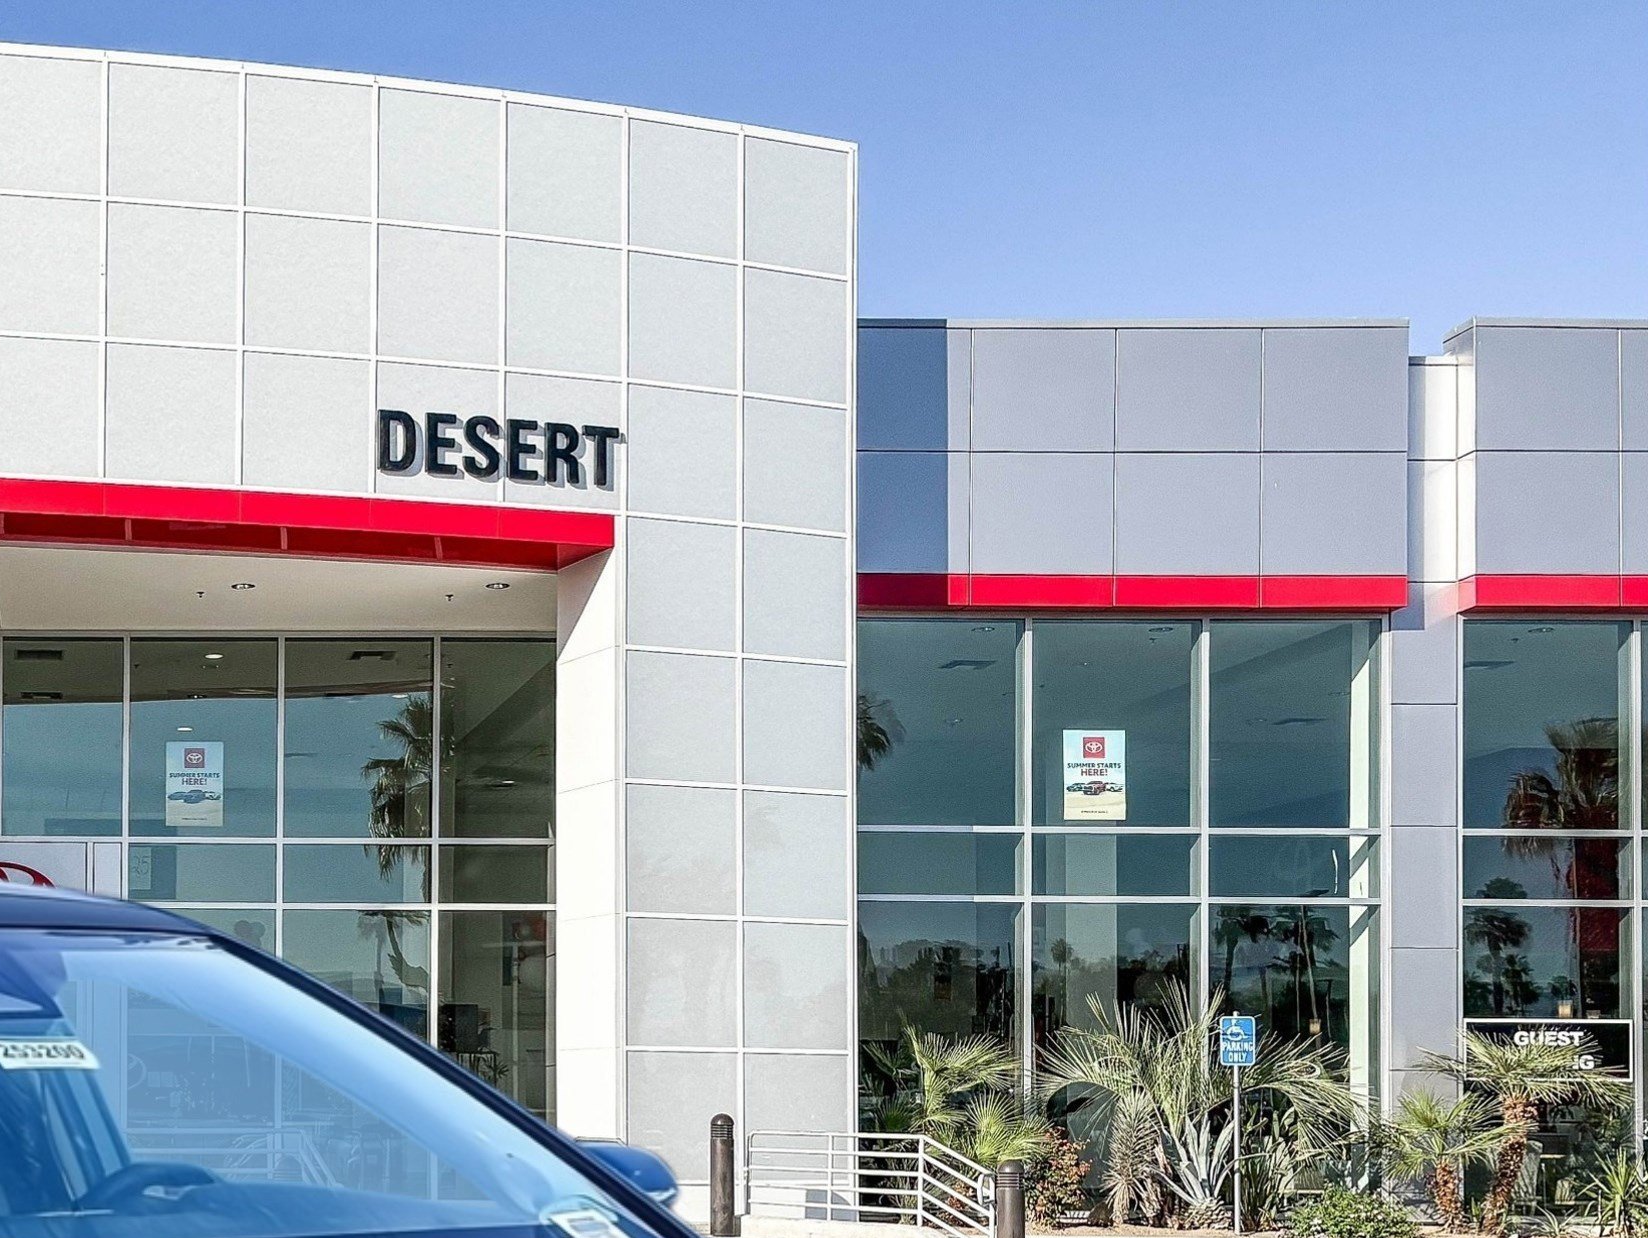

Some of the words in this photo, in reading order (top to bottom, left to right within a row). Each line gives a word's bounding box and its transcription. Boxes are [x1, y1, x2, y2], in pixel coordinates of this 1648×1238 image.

[376, 408, 620, 487] DESERT
[1080, 768, 1108, 776] HERE!
[1513, 1031, 1584, 1047] GUEST
[1222, 1041, 1253, 1052] PARKING
[1228, 1052, 1247, 1062] ONLY
